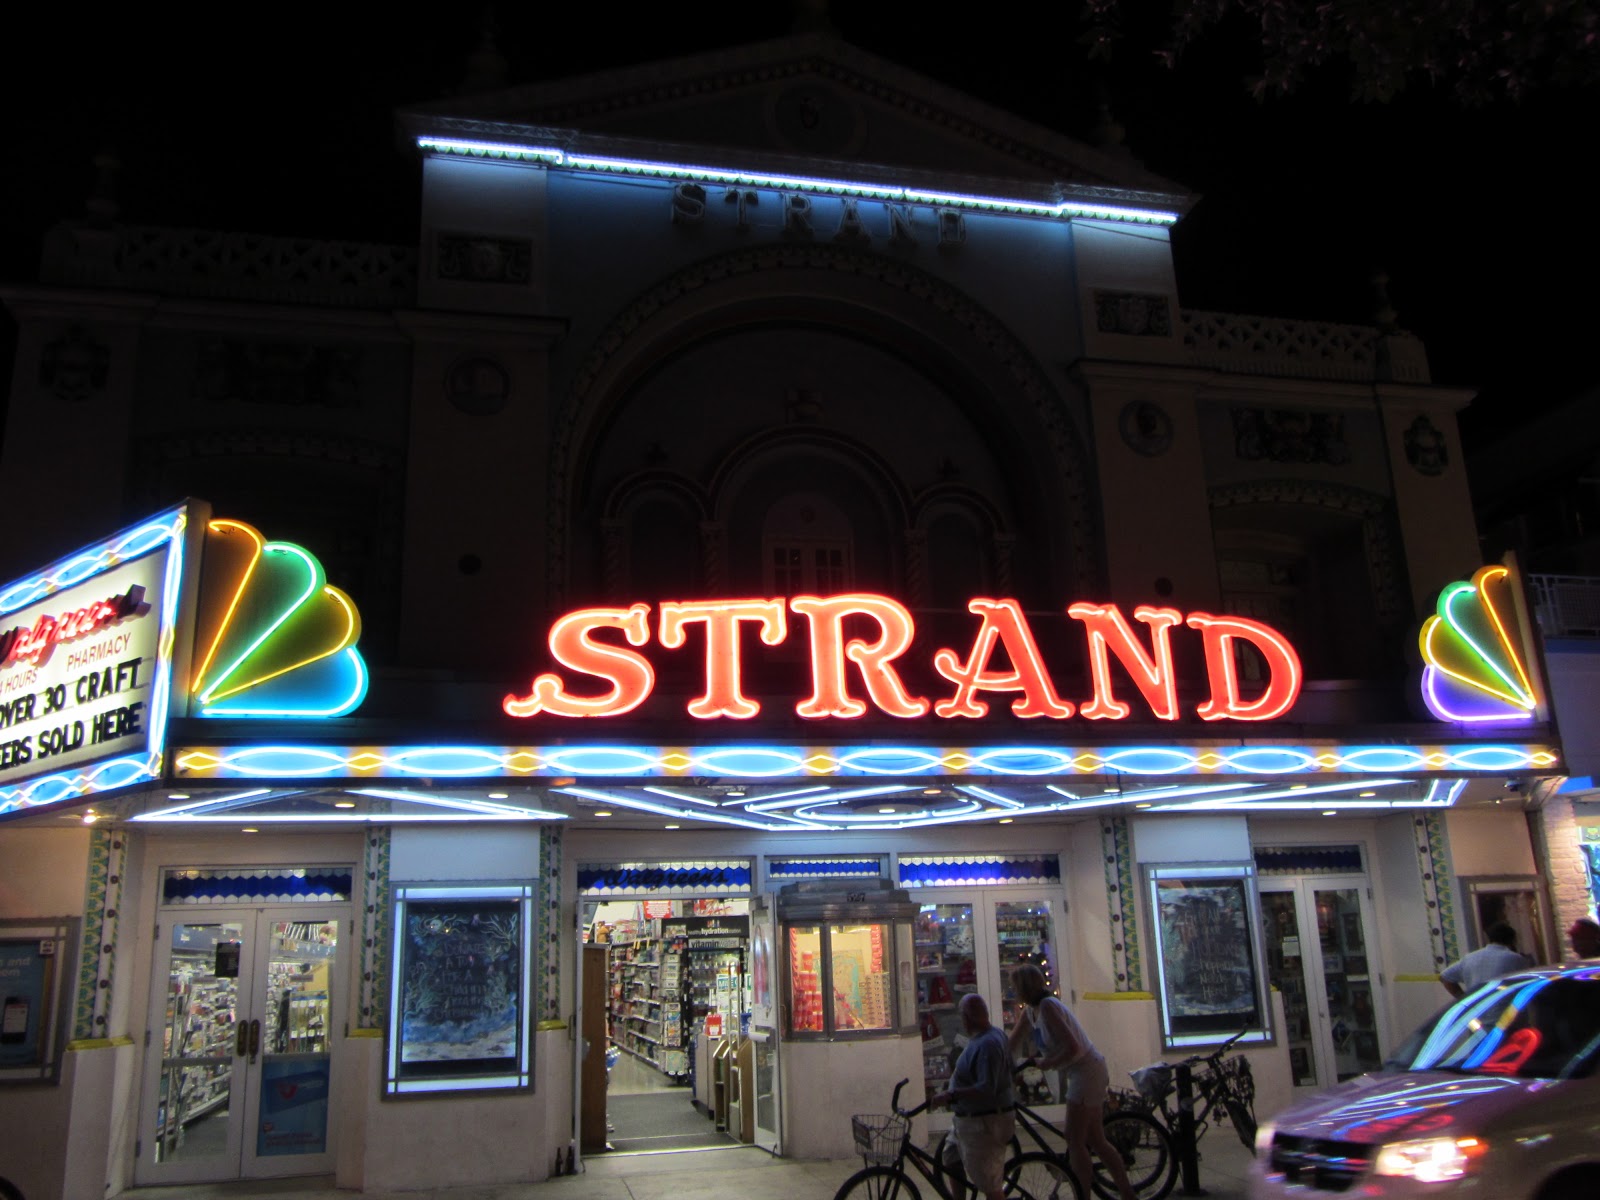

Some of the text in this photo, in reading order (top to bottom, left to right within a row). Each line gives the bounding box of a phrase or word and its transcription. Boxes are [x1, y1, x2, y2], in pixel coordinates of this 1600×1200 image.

[671, 182, 967, 248] STRAND
[4, 667, 39, 694] HOURS
[66, 632, 131, 672] PHARMACY
[503, 593, 1303, 721] STRAND
[43, 683, 66, 715] 30
[76, 657, 142, 705] CRAFT
[0, 702, 144, 770] ERS SOLD HERE
[602, 868, 728, 891] Walgreens
